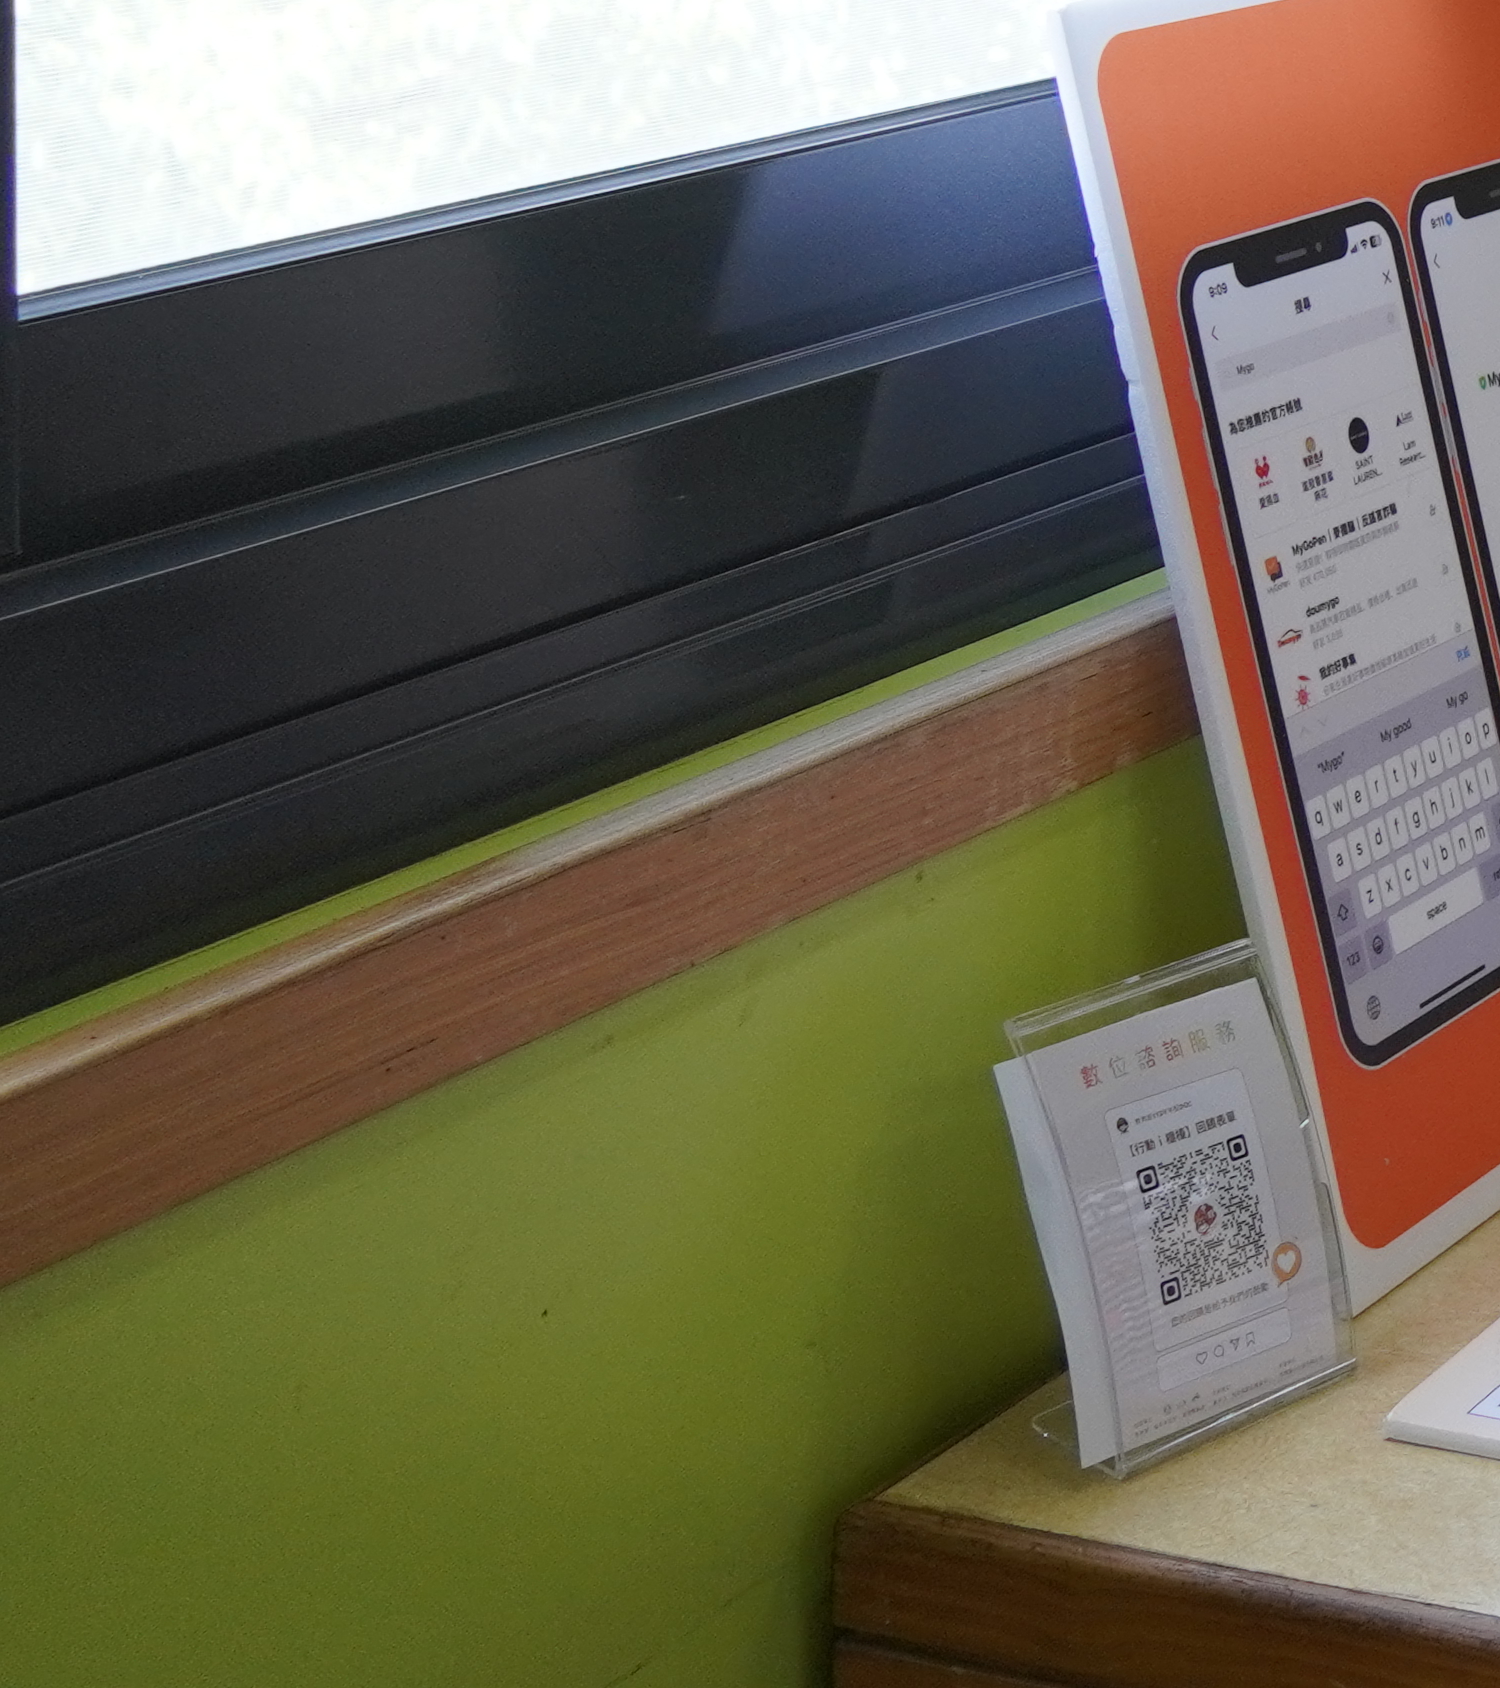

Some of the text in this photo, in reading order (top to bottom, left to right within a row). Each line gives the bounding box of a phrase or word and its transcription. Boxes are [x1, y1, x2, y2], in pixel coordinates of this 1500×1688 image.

[1209, 283, 1228, 297] 9:09
[1355, 456, 1373, 469] SAINT
[1292, 534, 1327, 556] MyGoPen
[1315, 811, 1323, 826] q
[1333, 801, 1344, 814] w
[1354, 791, 1362, 802] e
[1374, 781, 1380, 793] r
[1393, 769, 1399, 783] t
[1411, 760, 1419, 778] y
[1429, 751, 1437, 764] u
[1465, 733, 1472, 745] o
[1482, 722, 1490, 739] p
[1336, 854, 1344, 866] a
[1356, 843, 1363, 855] s
[1375, 829, 1383, 845] d
[1394, 820, 1400, 835] f
[1412, 812, 1421, 829] g
[1430, 799, 1438, 814] h
[1467, 780, 1474, 795] k
[1366, 826, 1485, 903] z x c v b n m
[1427, 901, 1448, 921] space
[1347, 952, 1360, 965] 123
[1081, 1020, 1236, 1088] 數位諮詢服務
[1196, 1111, 1237, 1134] 回饋表單
